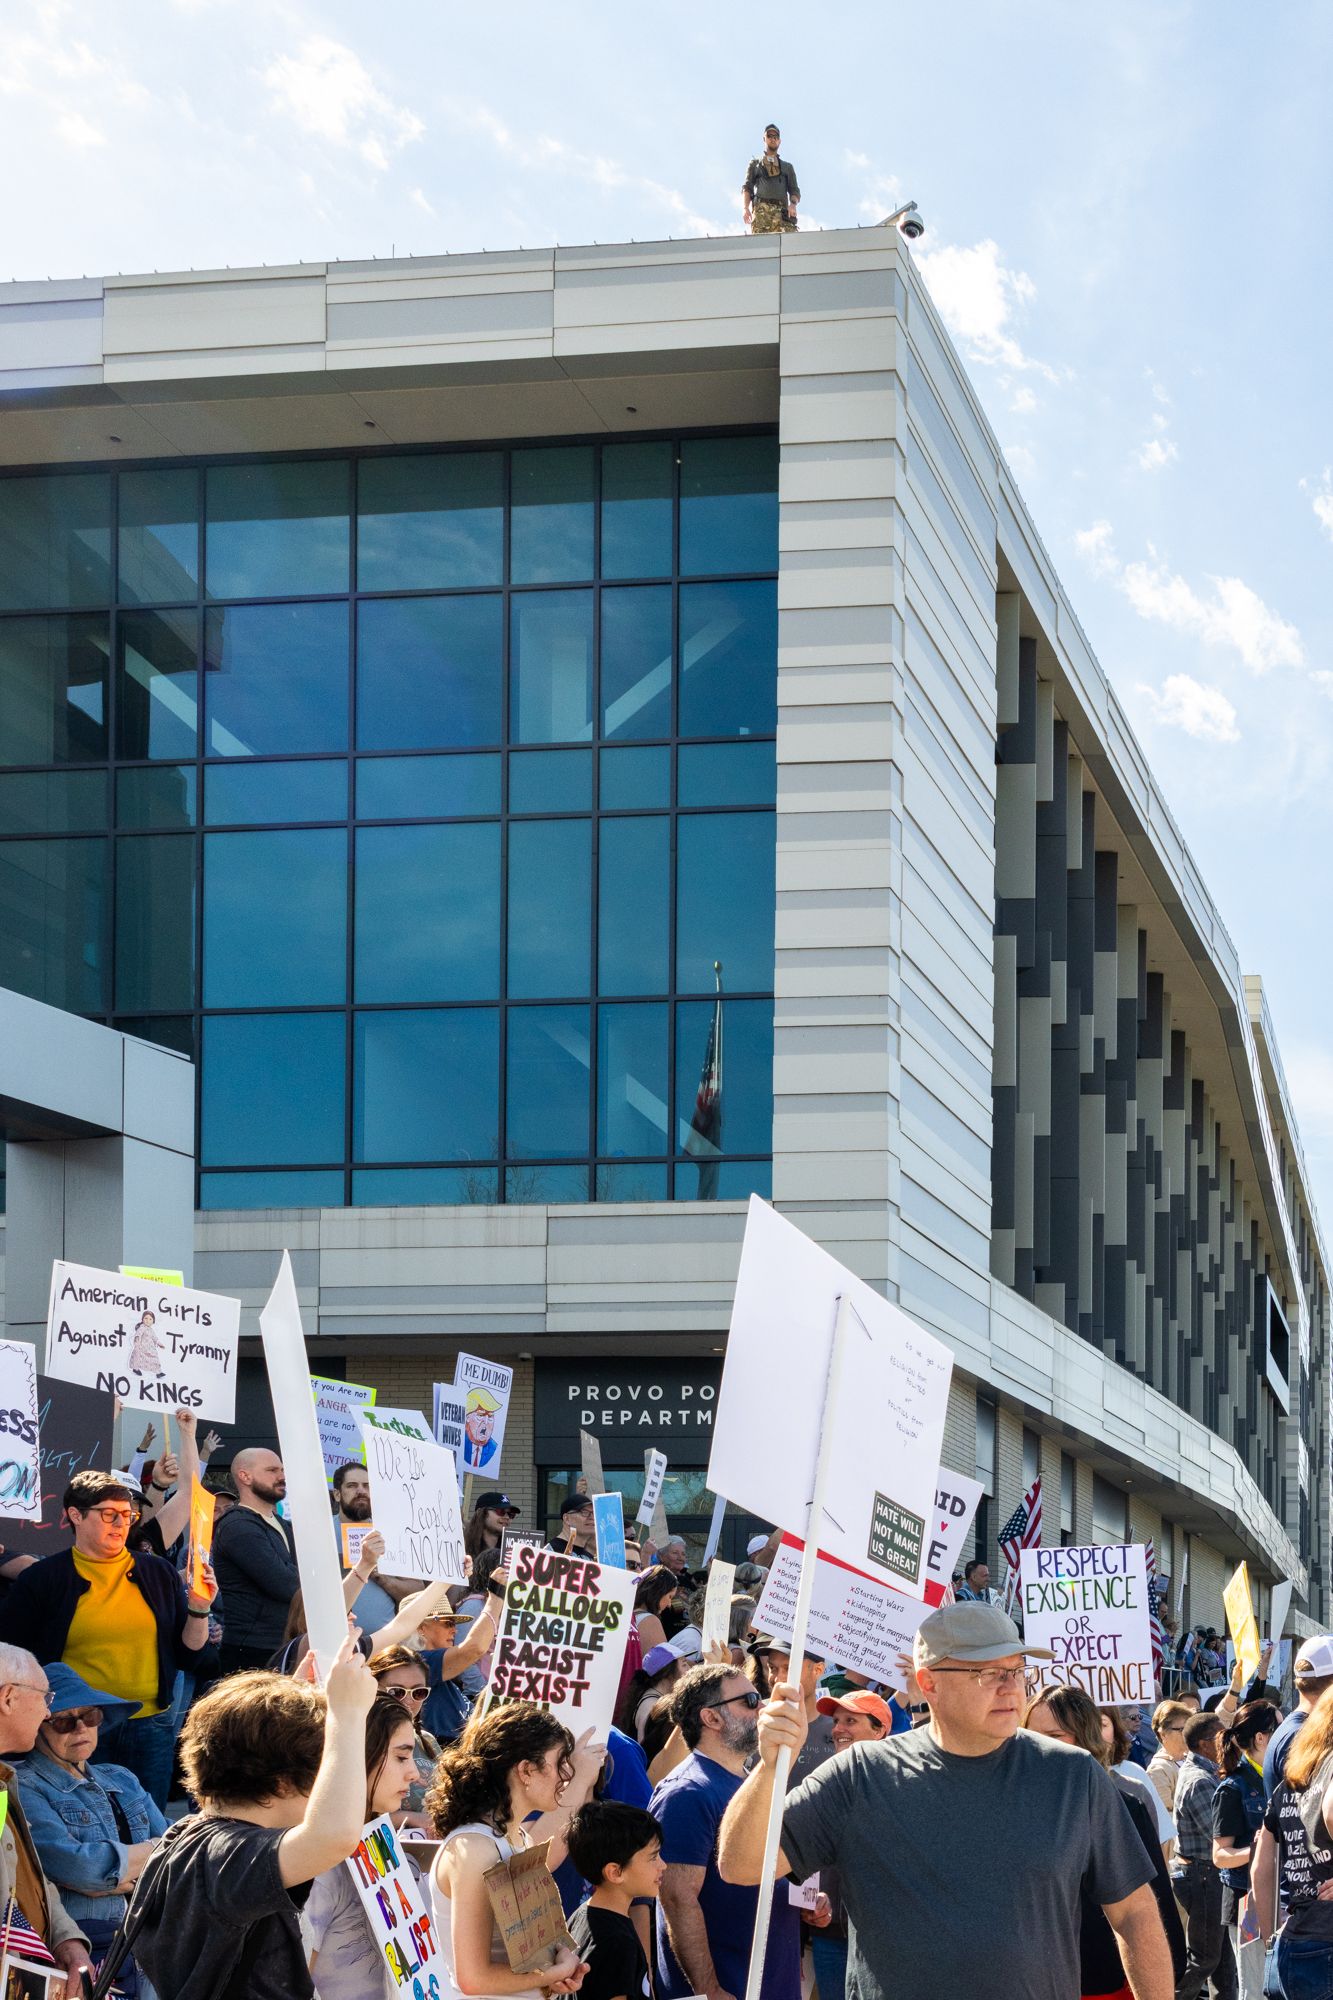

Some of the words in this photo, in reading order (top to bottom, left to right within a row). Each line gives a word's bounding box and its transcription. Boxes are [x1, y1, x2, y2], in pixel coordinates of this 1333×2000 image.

[61, 1277, 148, 1311] American
[159, 1297, 212, 1326] Girls
[57, 1321, 126, 1355] Against
[166, 1331, 231, 1373] Tyranny
[465, 1363, 480, 1379] ME
[96, 1371, 131, 1396] NO
[139, 1379, 203, 1407] KINGS
[355, 1391, 367, 1399] not
[568, 1385, 664, 1401] PROVO
[681, 1385, 715, 1401] PO
[317, 1398, 352, 1414] ANGR
[581, 1410, 712, 1425] DEPARTM
[324, 1419, 339, 1428] are
[342, 1422, 356, 1431] not
[876, 1501, 899, 1525] HATE
[900, 1516, 920, 1538] WILL
[934, 1489, 967, 1517] ID
[874, 1520, 893, 1540] NOT
[894, 1532, 919, 1556] MAKE
[410, 1535, 434, 1575] NO
[871, 1539, 885, 1556] US
[886, 1548, 917, 1573] GREAT
[1037, 1545, 1132, 1578] RESPECT
[516, 1547, 602, 1597] SUPER
[506, 1580, 623, 1631] CALLOUS
[854, 1587, 884, 1608] Starting
[1026, 1576, 1138, 1614] EXISTENCE
[503, 1609, 606, 1652] FRAGILE
[841, 1623, 880, 1646] objectifying
[846, 1610, 874, 1631] targeting
[875, 1623, 885, 1632] the
[1065, 1615, 1094, 1635] OR
[498, 1638, 594, 1680] RACIST
[834, 1645, 863, 1667] inciting
[864, 1659, 893, 1677] violence
[837, 1633, 860, 1653] Being
[861, 1647, 887, 1664] greedy
[1050, 1634, 1122, 1664] EXPECT
[491, 1665, 591, 1707] SEXIST
[350, 1823, 400, 1889] TRUMP
[376, 1885, 397, 1930] IS
[393, 1878, 413, 1920] A
